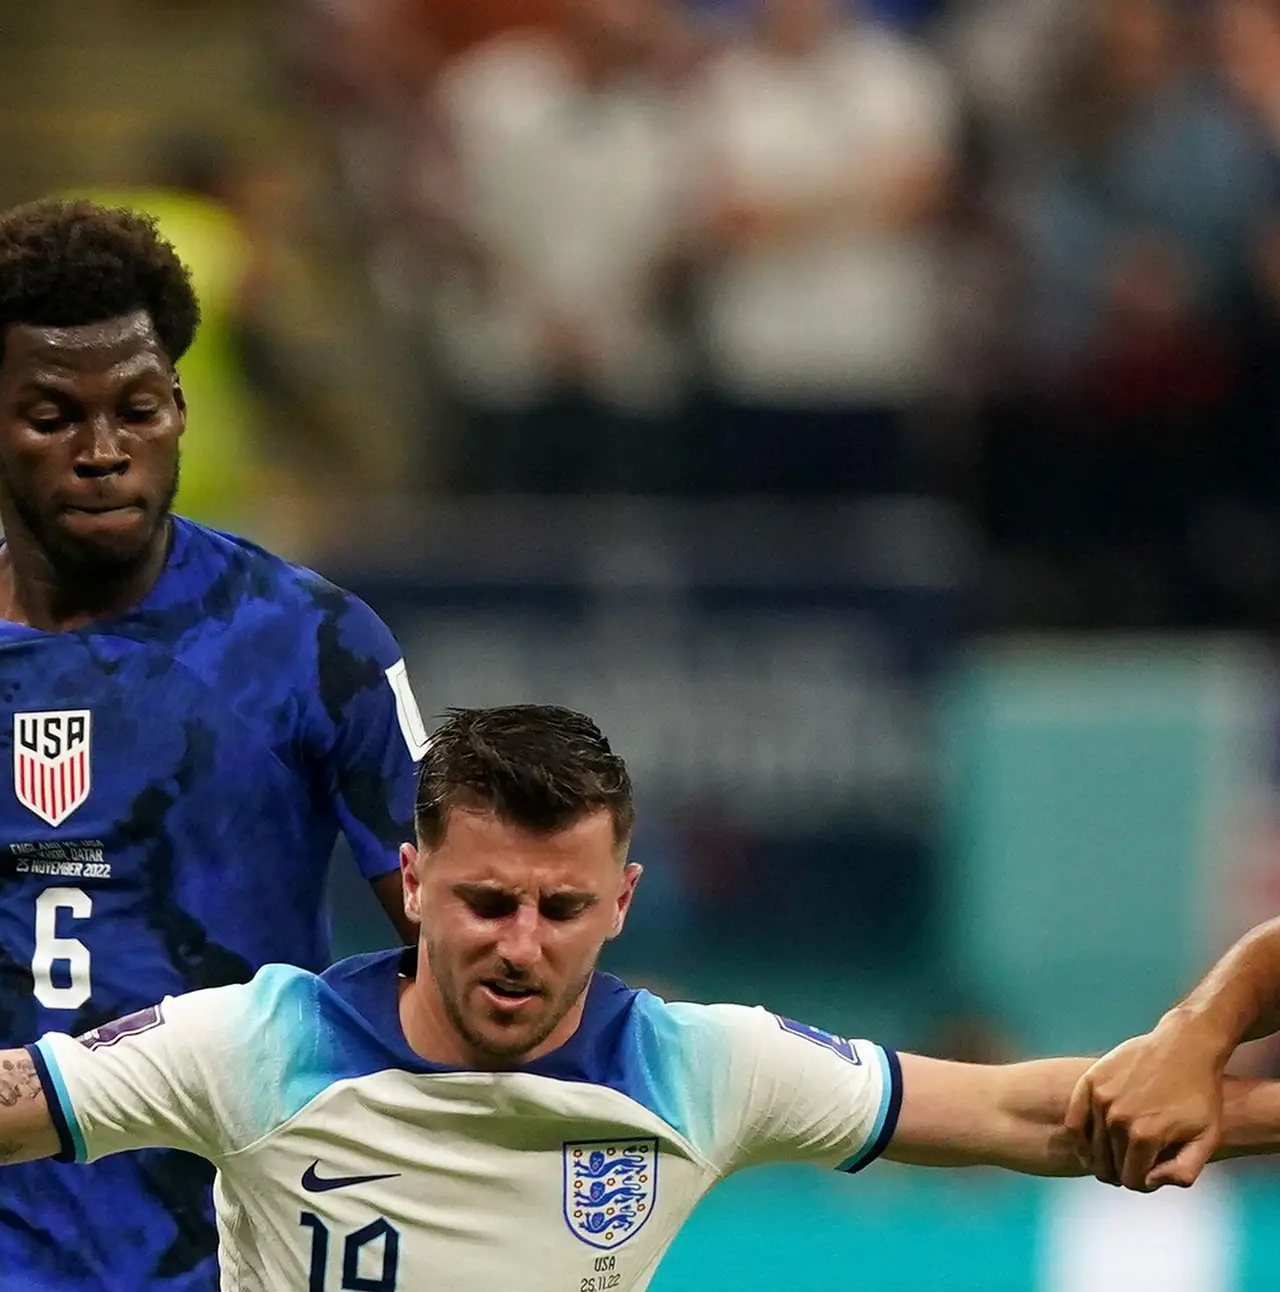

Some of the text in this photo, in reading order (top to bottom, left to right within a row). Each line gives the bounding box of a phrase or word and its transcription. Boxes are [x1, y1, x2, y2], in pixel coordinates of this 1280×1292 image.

[19, 715, 86, 760] USA
[71, 848, 105, 863] QATAR
[31, 860, 82, 877] NOVEMBER
[83, 863, 112, 879] 2022
[31, 886, 93, 1010] 6
[594, 1255, 616, 1272] USA
